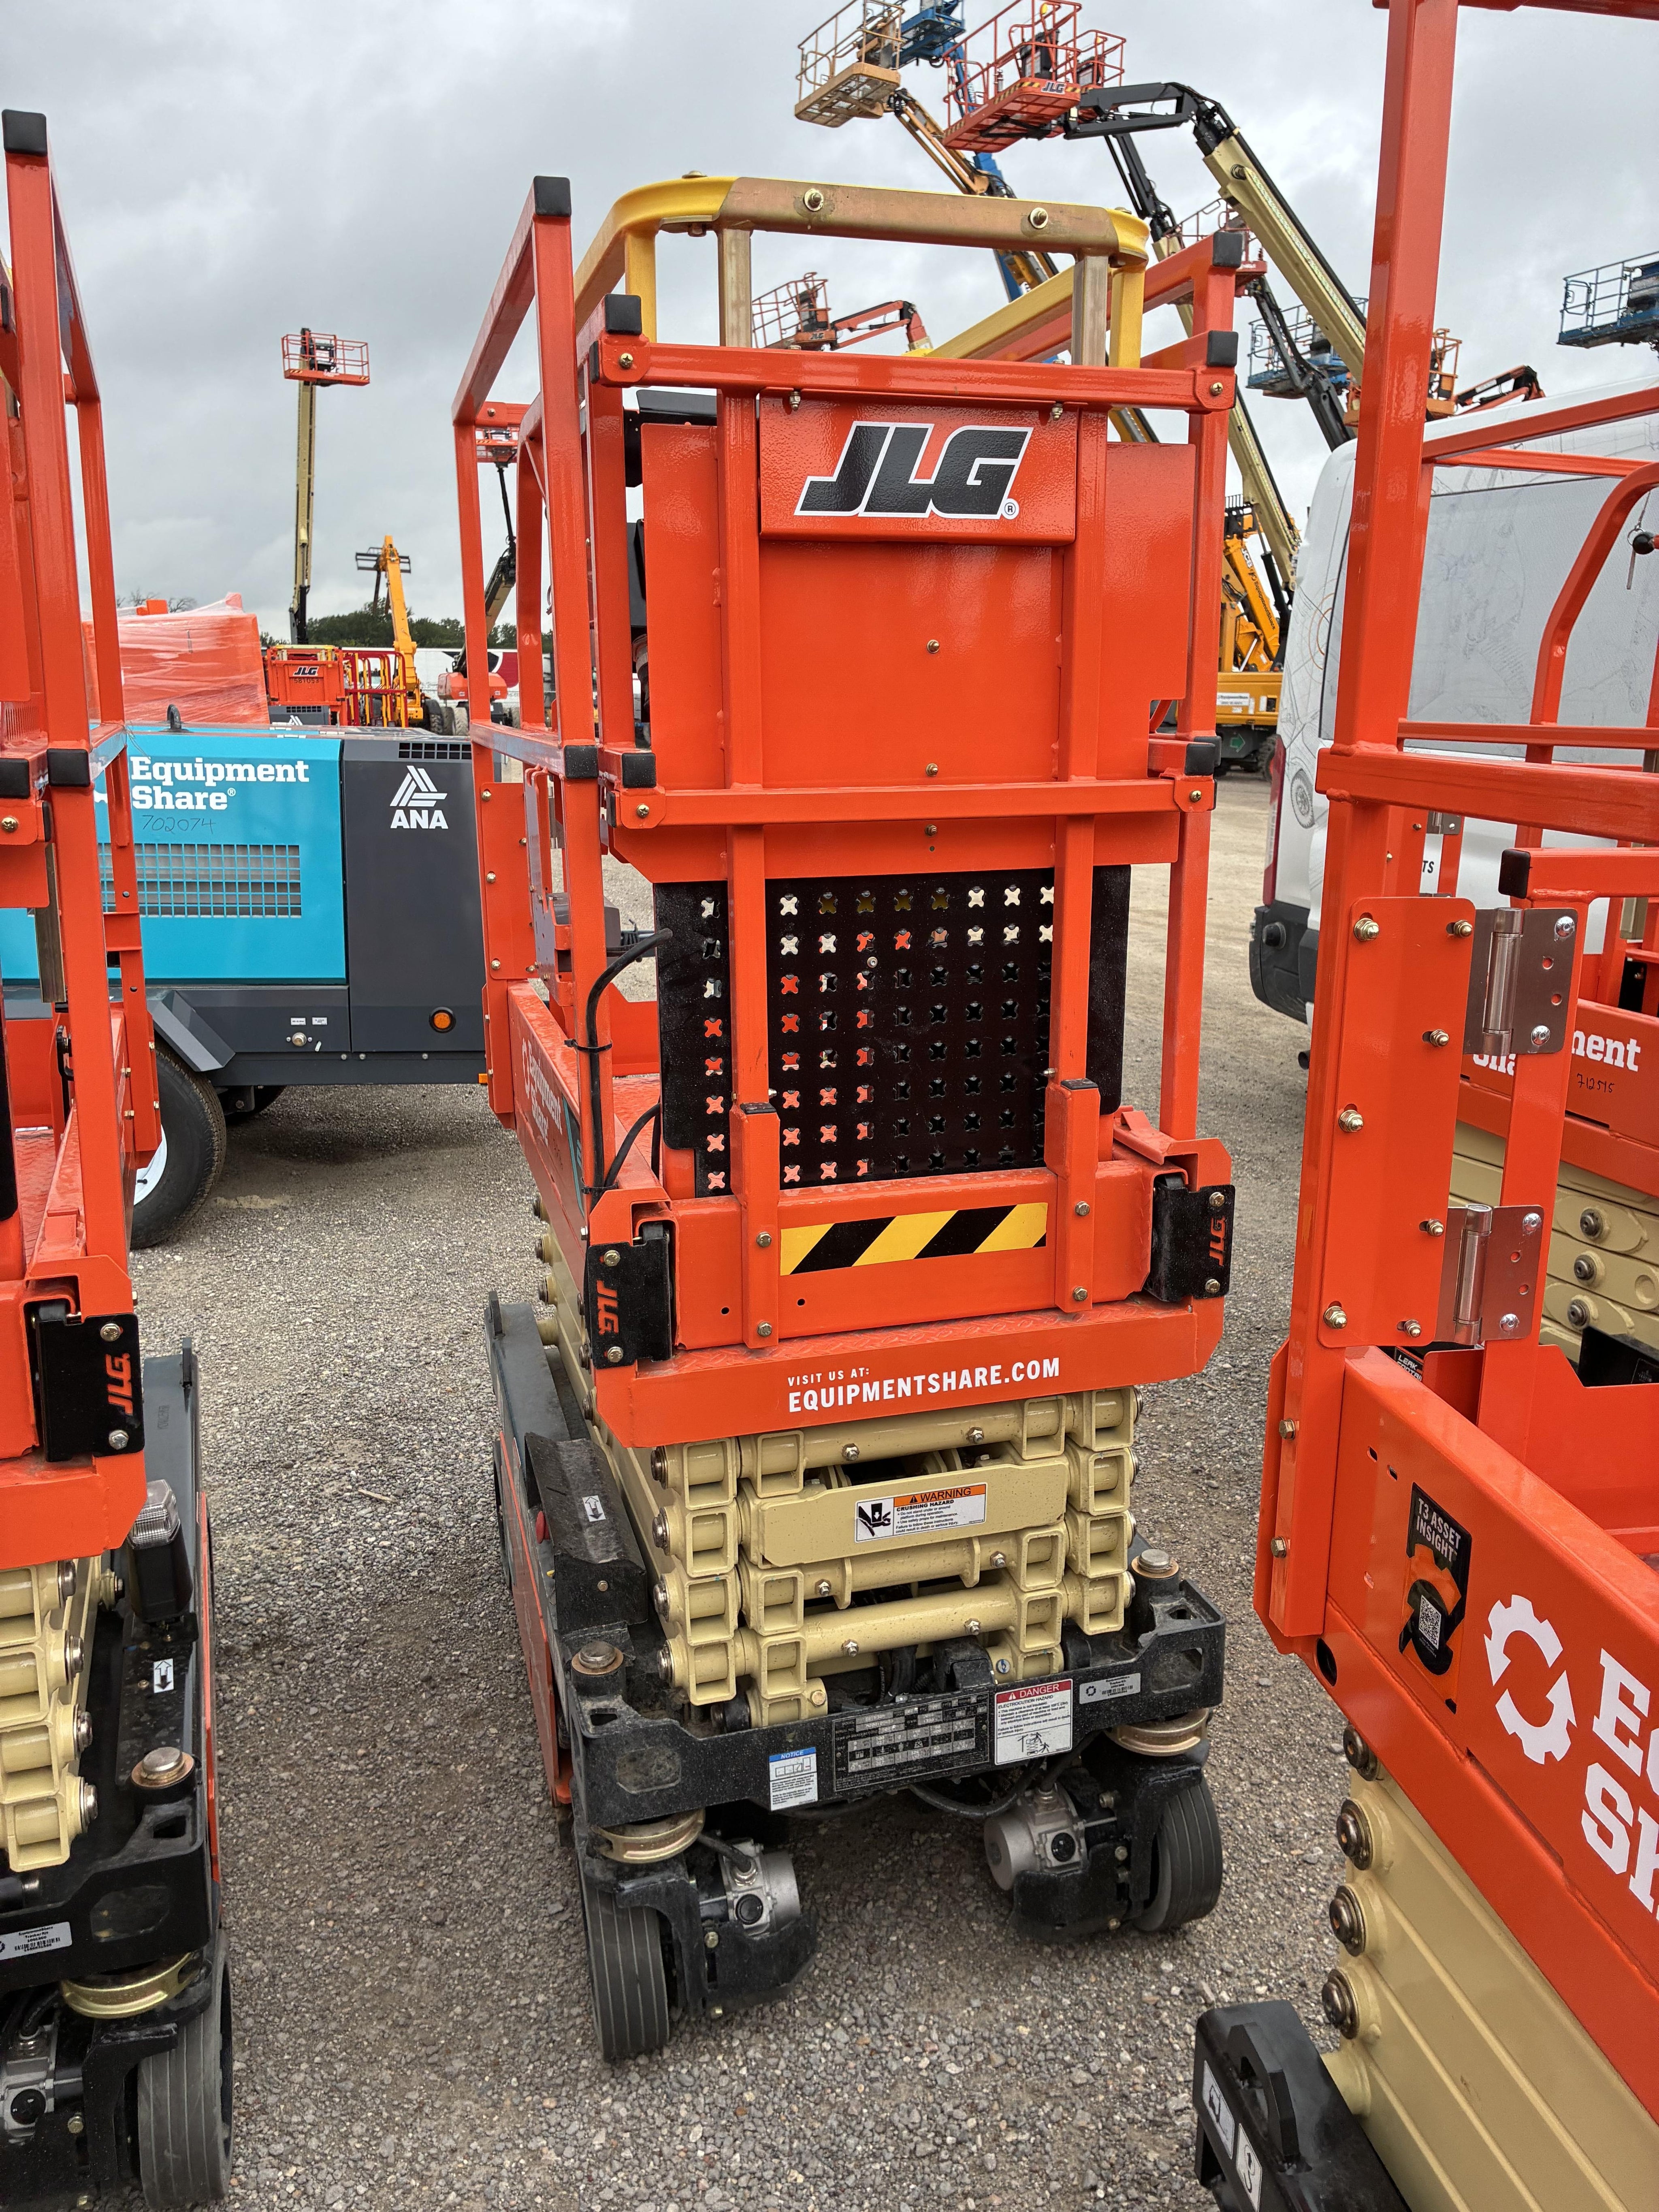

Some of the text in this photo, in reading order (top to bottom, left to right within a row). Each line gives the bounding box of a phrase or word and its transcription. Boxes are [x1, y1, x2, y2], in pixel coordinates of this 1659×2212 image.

[1041, 81, 1067, 94] JLG
[292, 666, 320, 677] JLG
[130, 756, 309, 787] Equipment
[142, 815, 216, 834] 702074
[390, 809, 449, 829] ANA
[1209, 1216, 1226, 1267] JLG
[596, 1280, 619, 1335] JLG
[1398, 1355, 1418, 1370] LEAK
[106, 1353, 134, 1415] JLG
[788, 1367, 870, 1386] VISIT US AT:
[789, 1357, 1060, 1413] EQUIPMENTSHARE.COM
[920, 1487, 971, 1502] WARNING
[897, 1503, 928, 1512] CRUSHING
[1418, 1498, 1461, 1549] T3 ASSET
[1020, 1684, 1060, 1698] DANGER
[998, 1699, 1035, 1709] ELECTROCUTION
[781, 1750, 804, 1759] NOTICE
